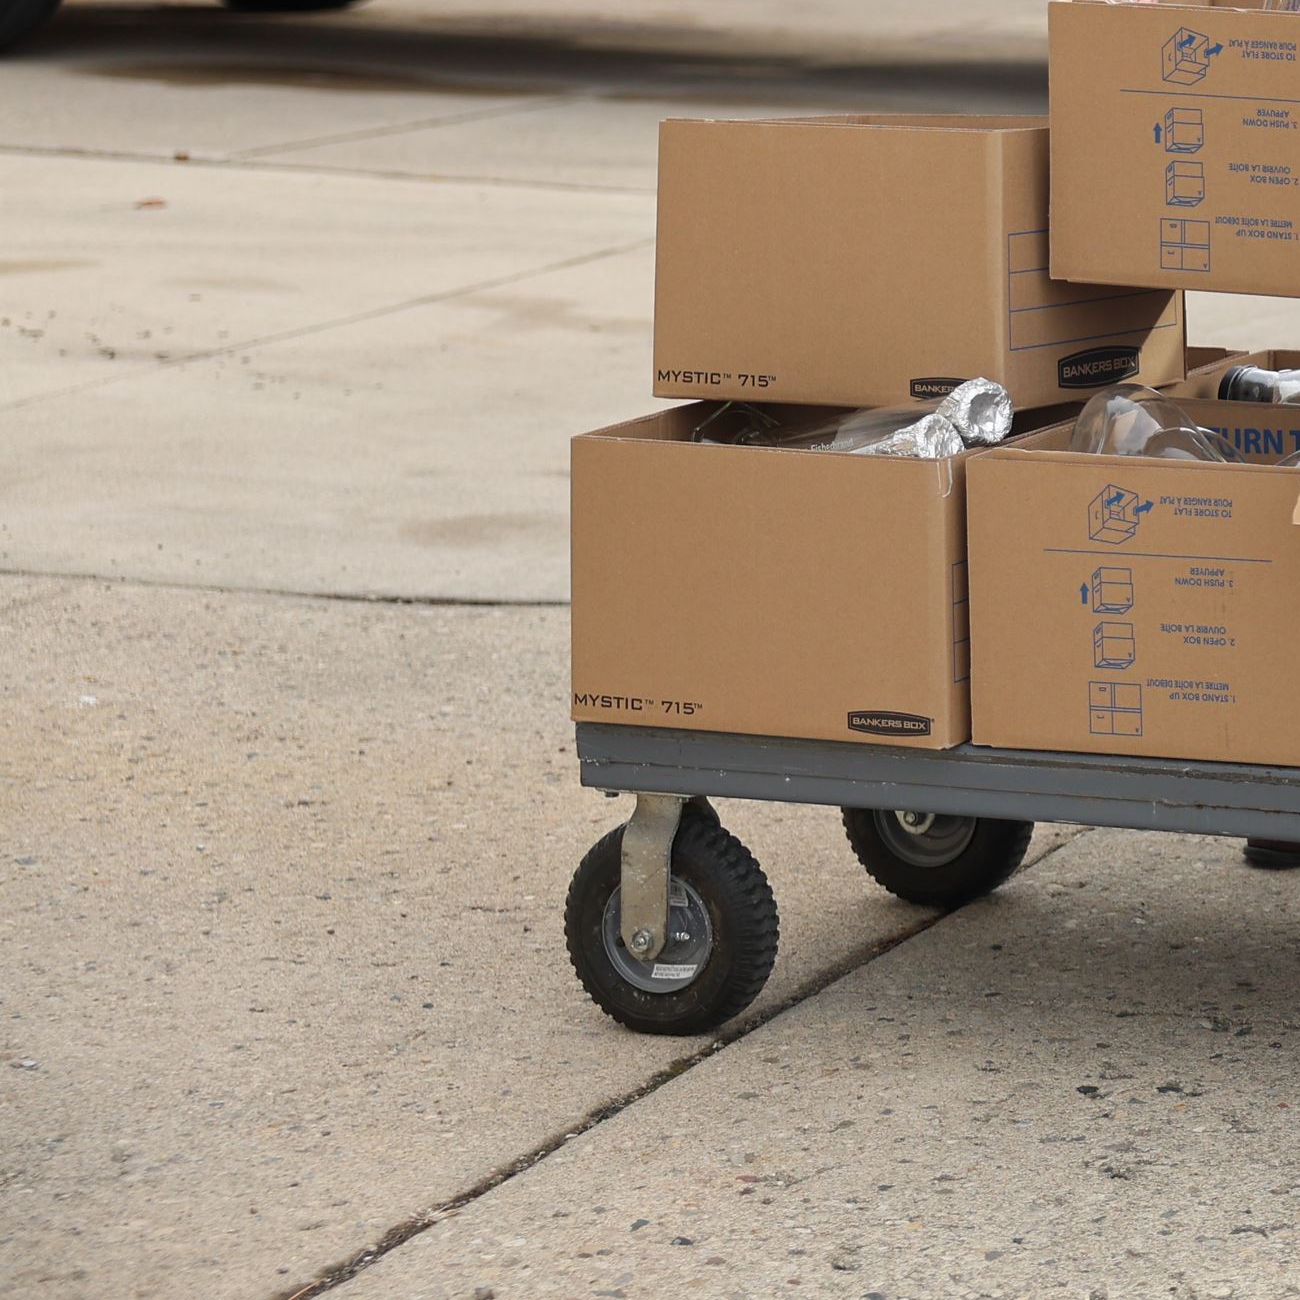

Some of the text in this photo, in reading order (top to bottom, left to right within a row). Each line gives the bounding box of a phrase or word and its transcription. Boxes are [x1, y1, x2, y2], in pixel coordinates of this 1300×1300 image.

[1242, 50, 1297, 61] TO STORE FLAT
[1257, 109, 1290, 118] APPUYER
[1242, 118, 1269, 127] DOWN
[1270, 120, 1290, 128] PUSH
[1251, 164, 1260, 172] LA
[1250, 175, 1267, 184] BOX
[1268, 176, 1291, 185] OPEN
[1261, 219, 1270, 227] LA
[1236, 229, 1246, 237] UP
[1248, 229, 1265, 238] BOX
[1267, 231, 1292, 240] STAND
[1063, 356, 1136, 378] BANKERS BOX
[914, 384, 955, 394] BANKER
[1174, 507, 1232, 518] TO STORE FLAT
[1190, 567, 1225, 576] APPUYER
[1174, 577, 1202, 586] DOWN
[1204, 579, 1224, 587] PUSH
[1184, 625, 1195, 633] LA
[1183, 636, 1201, 644] BOX
[1203, 637, 1227, 646] OPEN
[1195, 681, 1204, 689] LA
[1169, 692, 1180, 700] UP
[1182, 692, 1200, 701] BOX
[1202, 694, 1229, 702] STAND
[853, 718, 926, 730] BANKERS BOX
